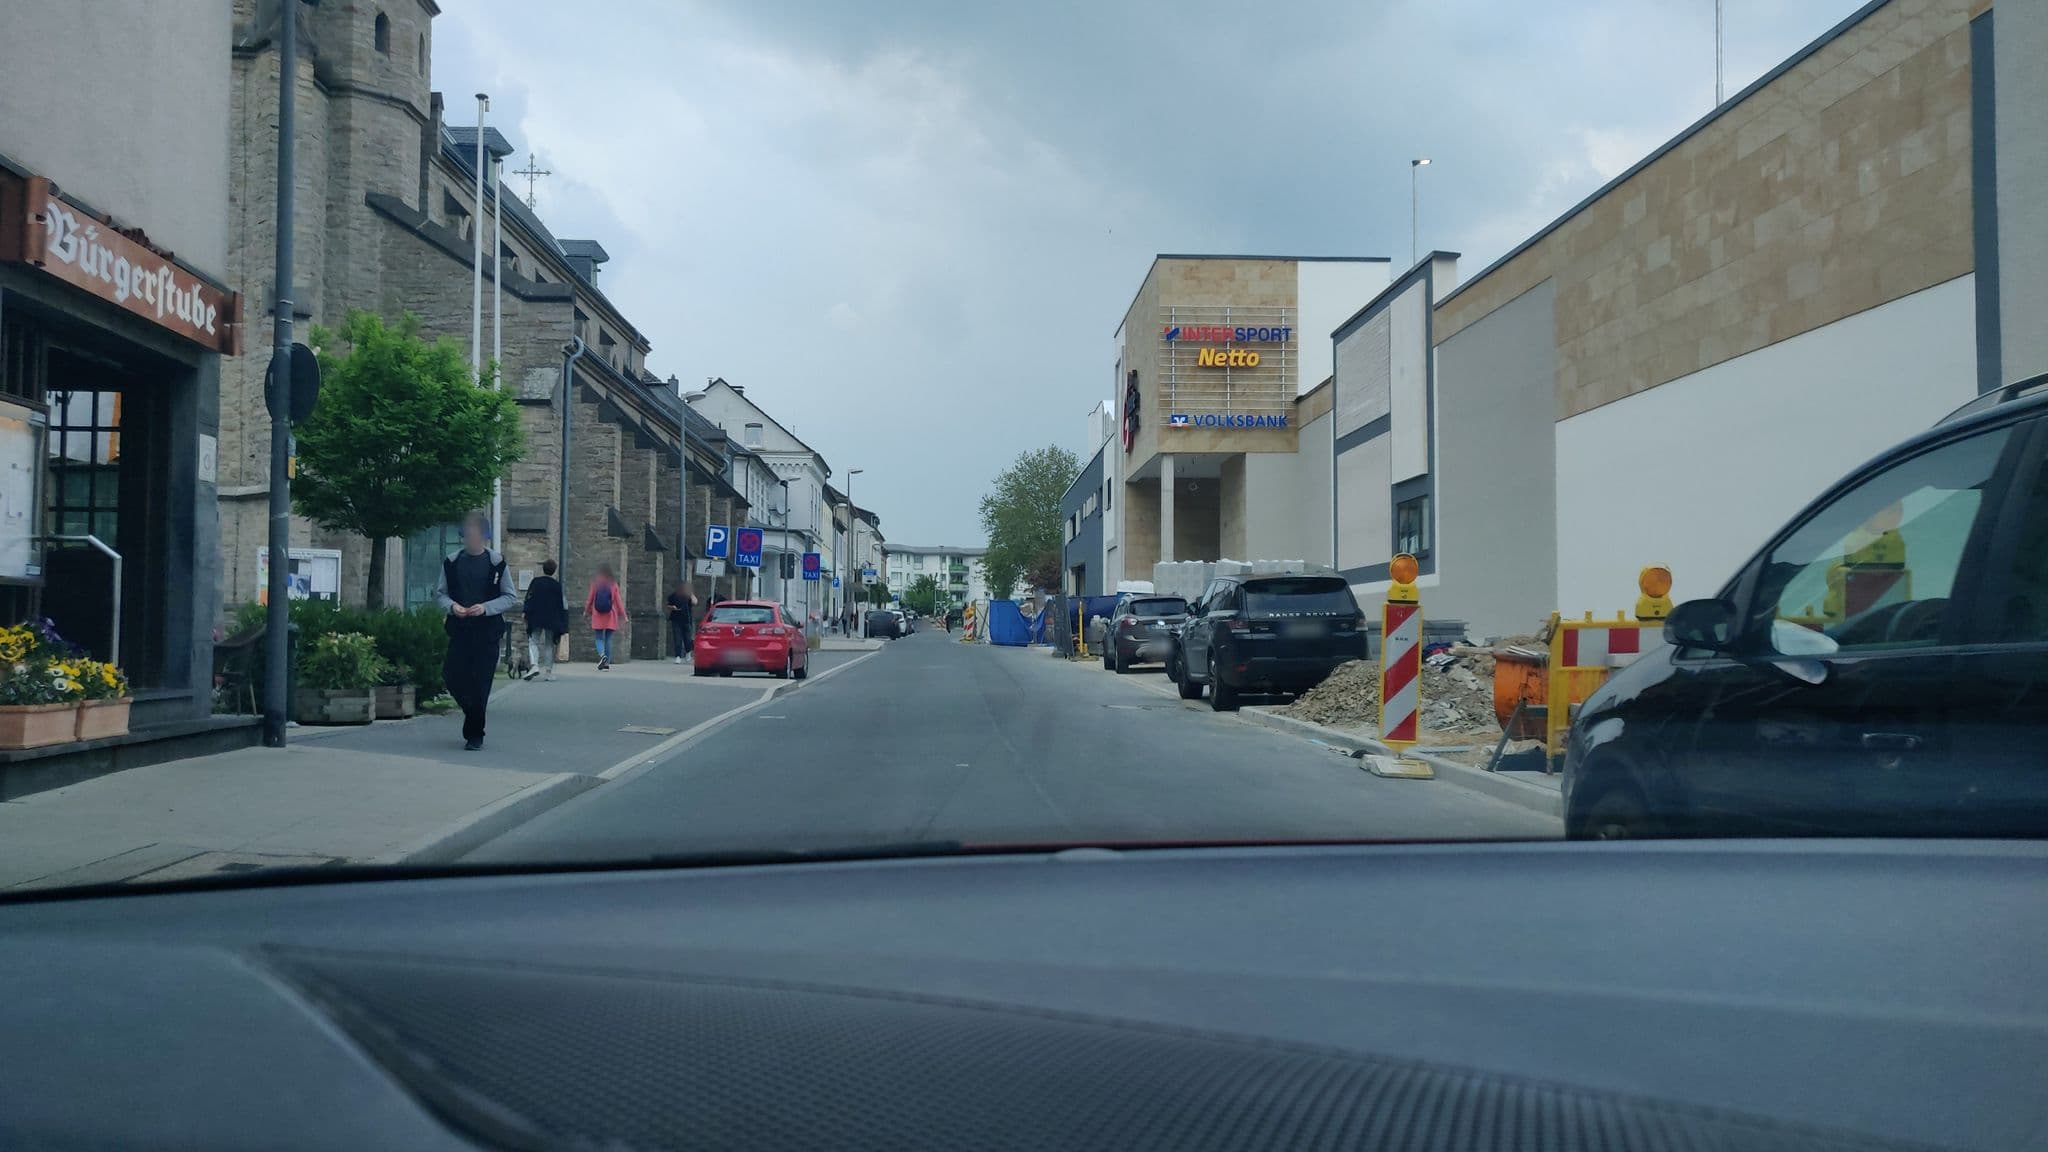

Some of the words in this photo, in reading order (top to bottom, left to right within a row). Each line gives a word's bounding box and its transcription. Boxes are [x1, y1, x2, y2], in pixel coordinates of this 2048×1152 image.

[1182, 326, 1292, 342] INTERSPORT
[1198, 348, 1260, 367] Netto
[1193, 414, 1288, 428] VOLKSBANK
[708, 528, 726, 550] P
[738, 554, 759, 564] TAXI
